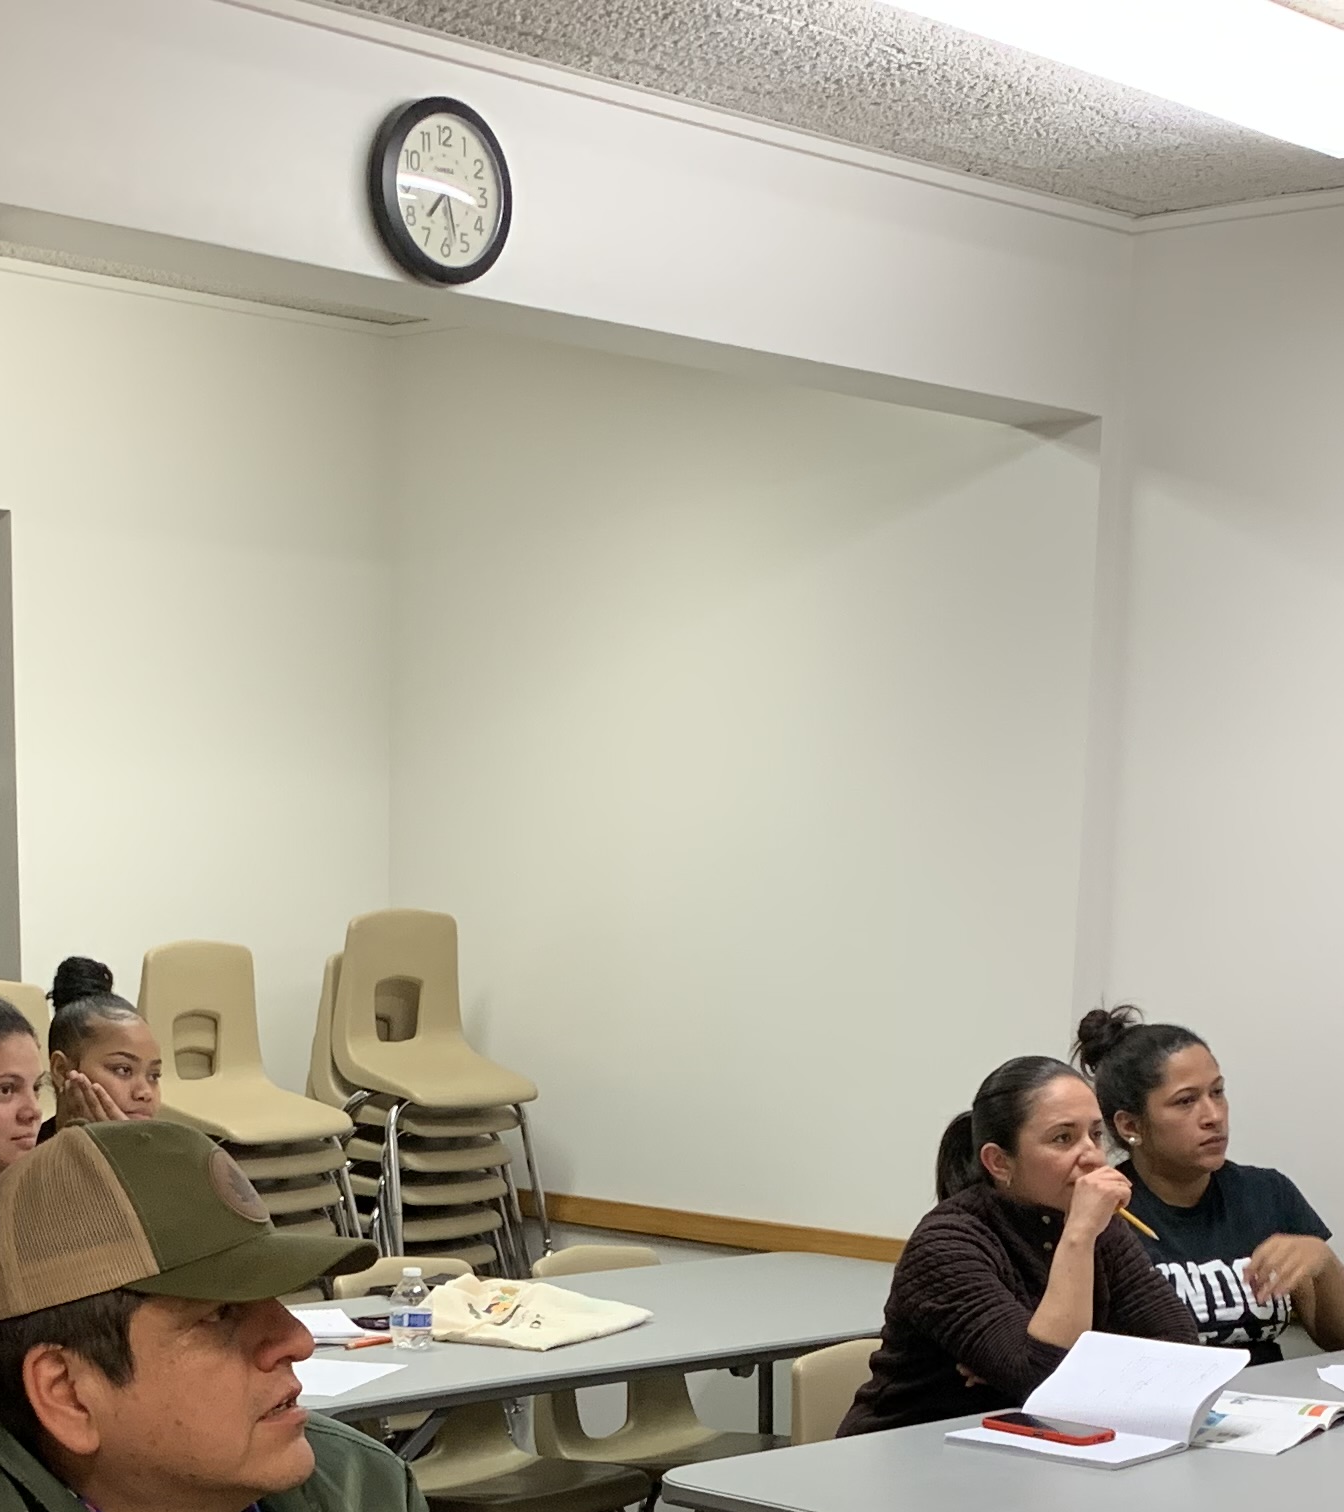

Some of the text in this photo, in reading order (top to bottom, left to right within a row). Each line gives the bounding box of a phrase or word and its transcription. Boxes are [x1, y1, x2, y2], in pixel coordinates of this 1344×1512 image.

[420, 131, 431, 152] 11
[437, 125, 452, 147] 12
[461, 136, 466, 157] 1
[404, 149, 421, 171] 10
[473, 158, 484, 180] 2
[477, 187, 488, 208] 3
[405, 205, 416, 226] 8
[474, 215, 484, 236] 4
[421, 226, 431, 247] 7
[460, 232, 470, 253] 5
[440, 237, 451, 258] 6
